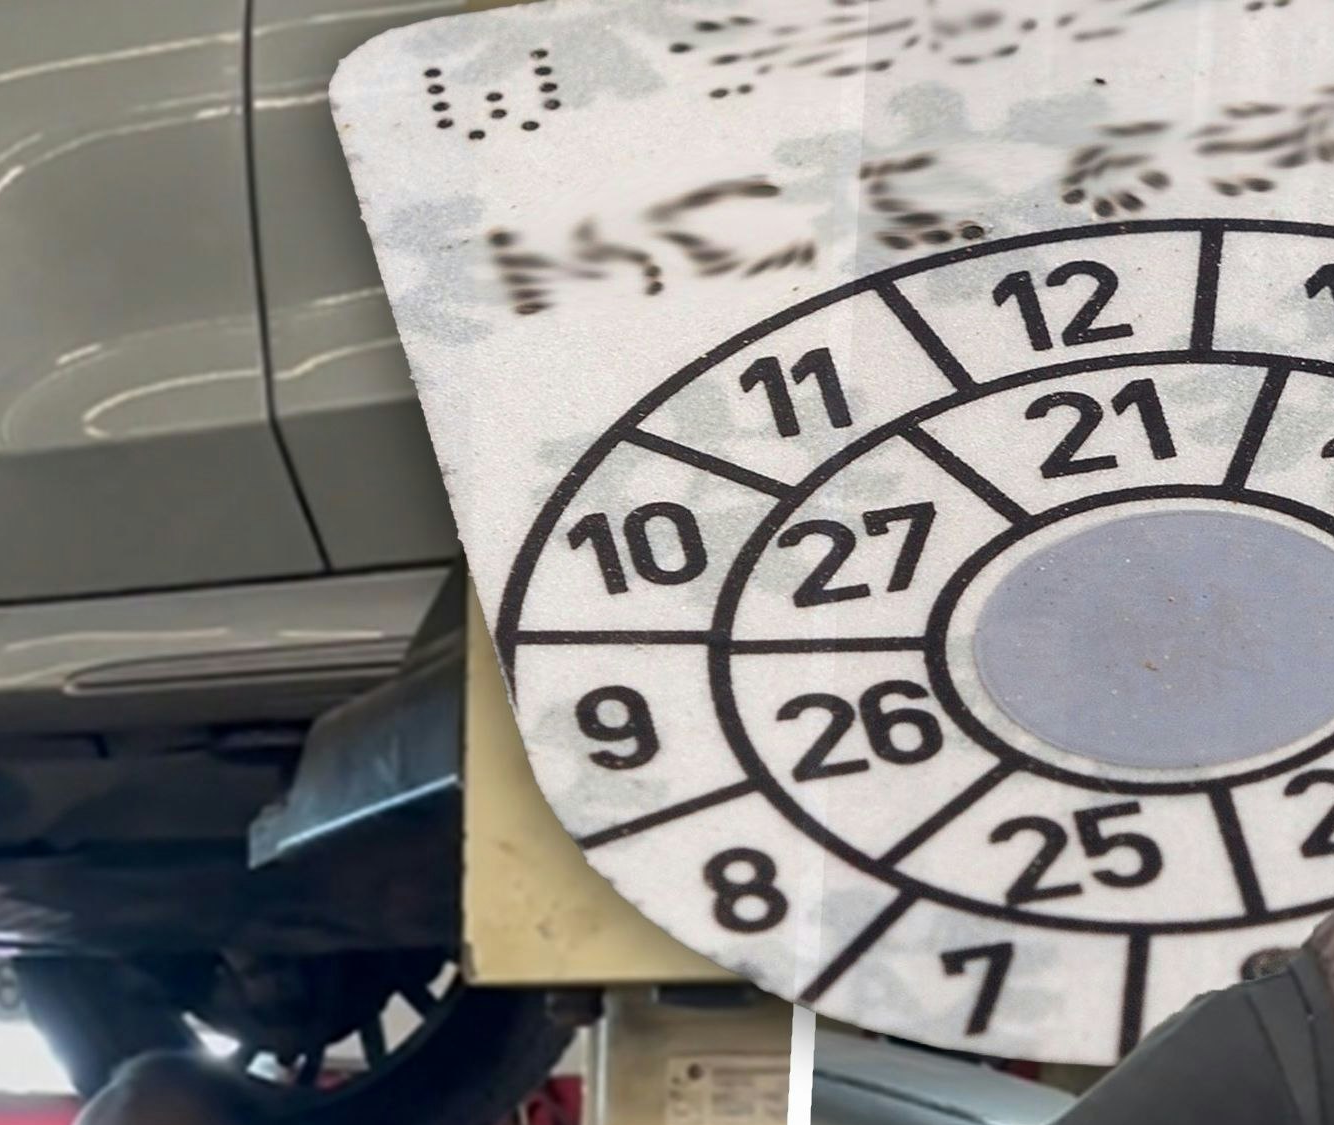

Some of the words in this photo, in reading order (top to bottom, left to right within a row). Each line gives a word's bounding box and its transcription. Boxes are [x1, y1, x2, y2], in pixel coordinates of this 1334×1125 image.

[992, 261, 1133, 351] 12
[740, 348, 852, 437] 11
[1025, 379, 1177, 479] 21
[567, 502, 707, 594] 10
[777, 502, 936, 607] 27
[576, 686, 659, 770] 9
[777, 680, 943, 782] 26
[704, 848, 788, 933] 8
[988, 801, 1162, 905] 25
[941, 942, 1014, 1035] 7
